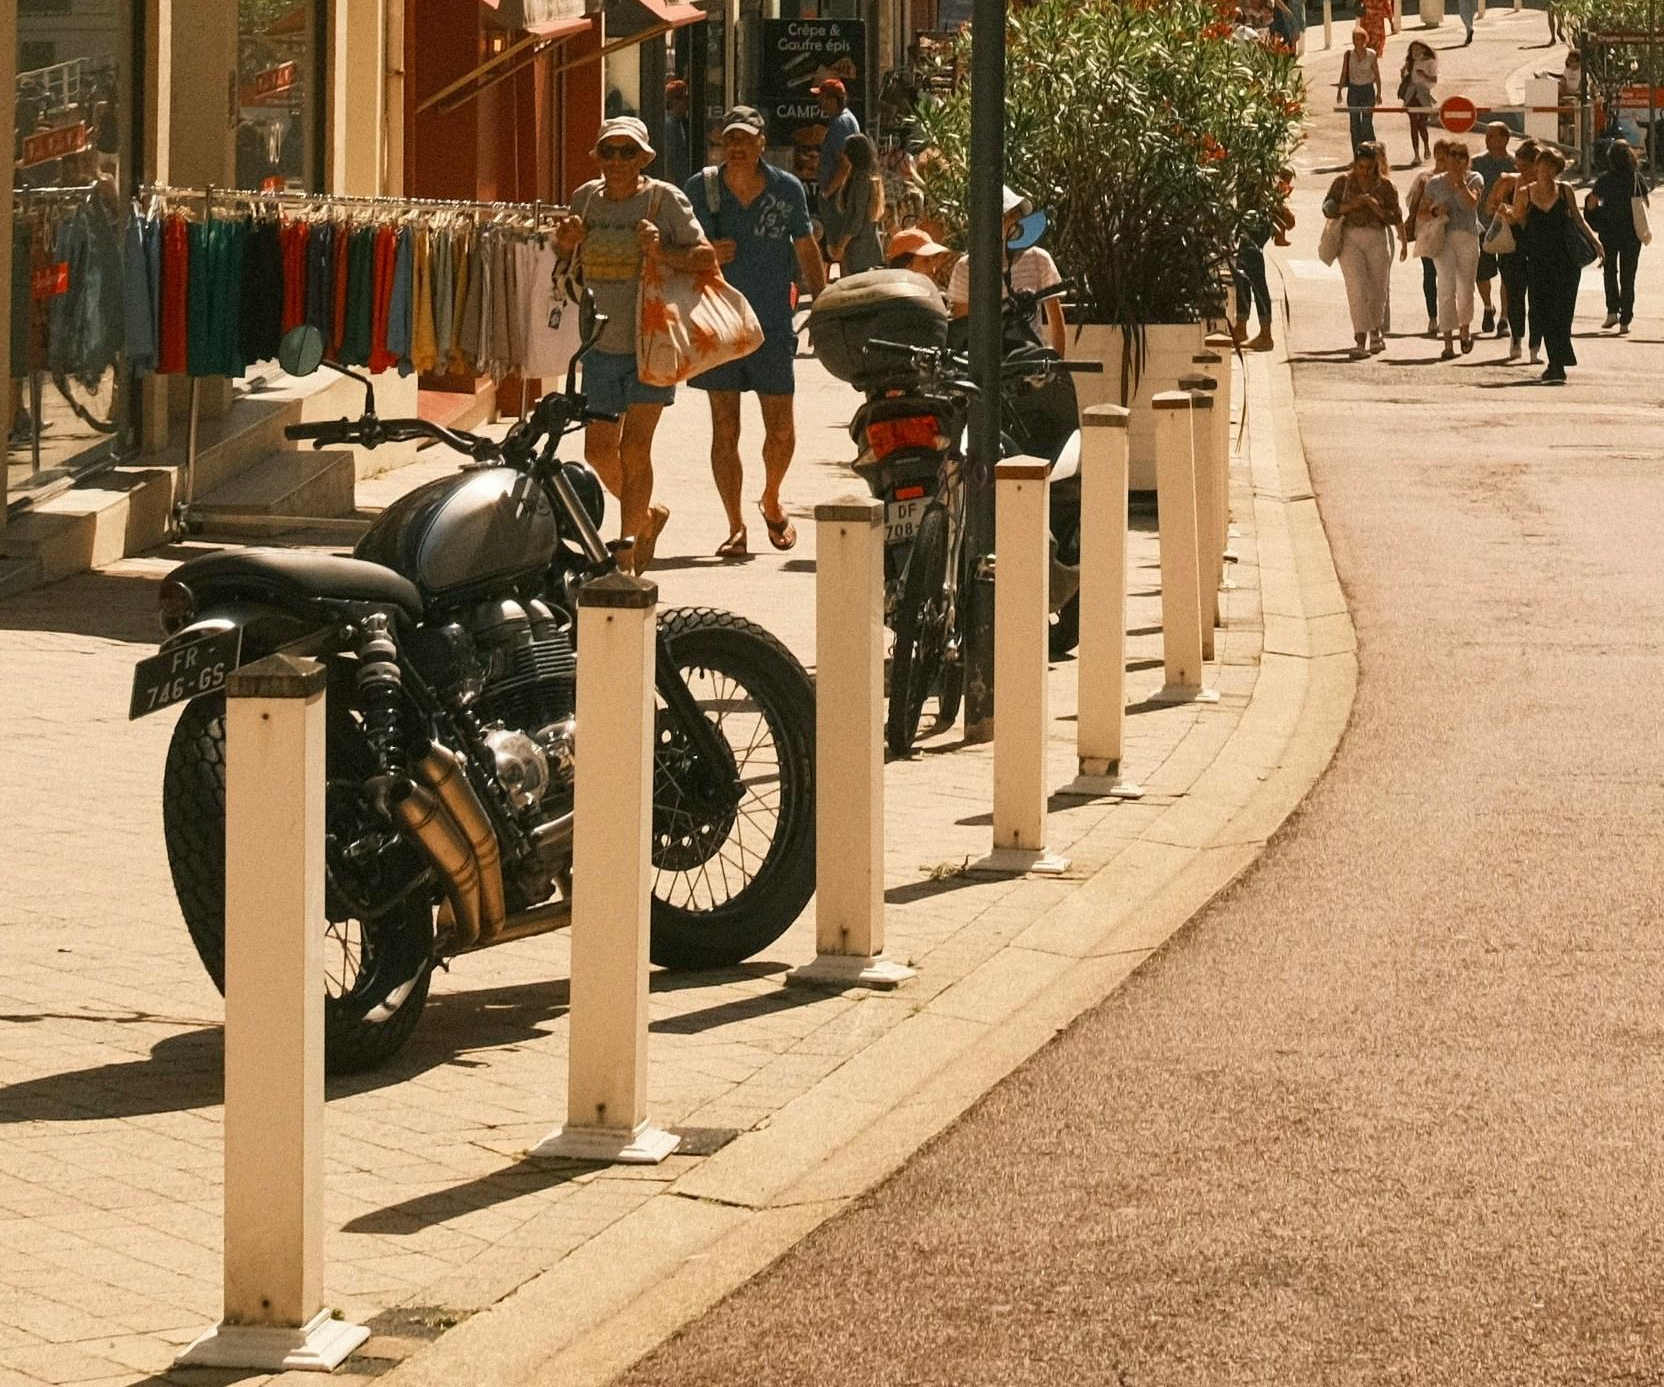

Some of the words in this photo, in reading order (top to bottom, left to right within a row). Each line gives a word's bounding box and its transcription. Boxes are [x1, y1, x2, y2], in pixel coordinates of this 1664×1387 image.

[788, 22, 826, 42] Crêpe
[830, 23, 841, 37] &
[777, 37, 823, 52] Gaufre
[898, 503, 917, 519] DF
[146, 662, 225, 709] 746-GS
